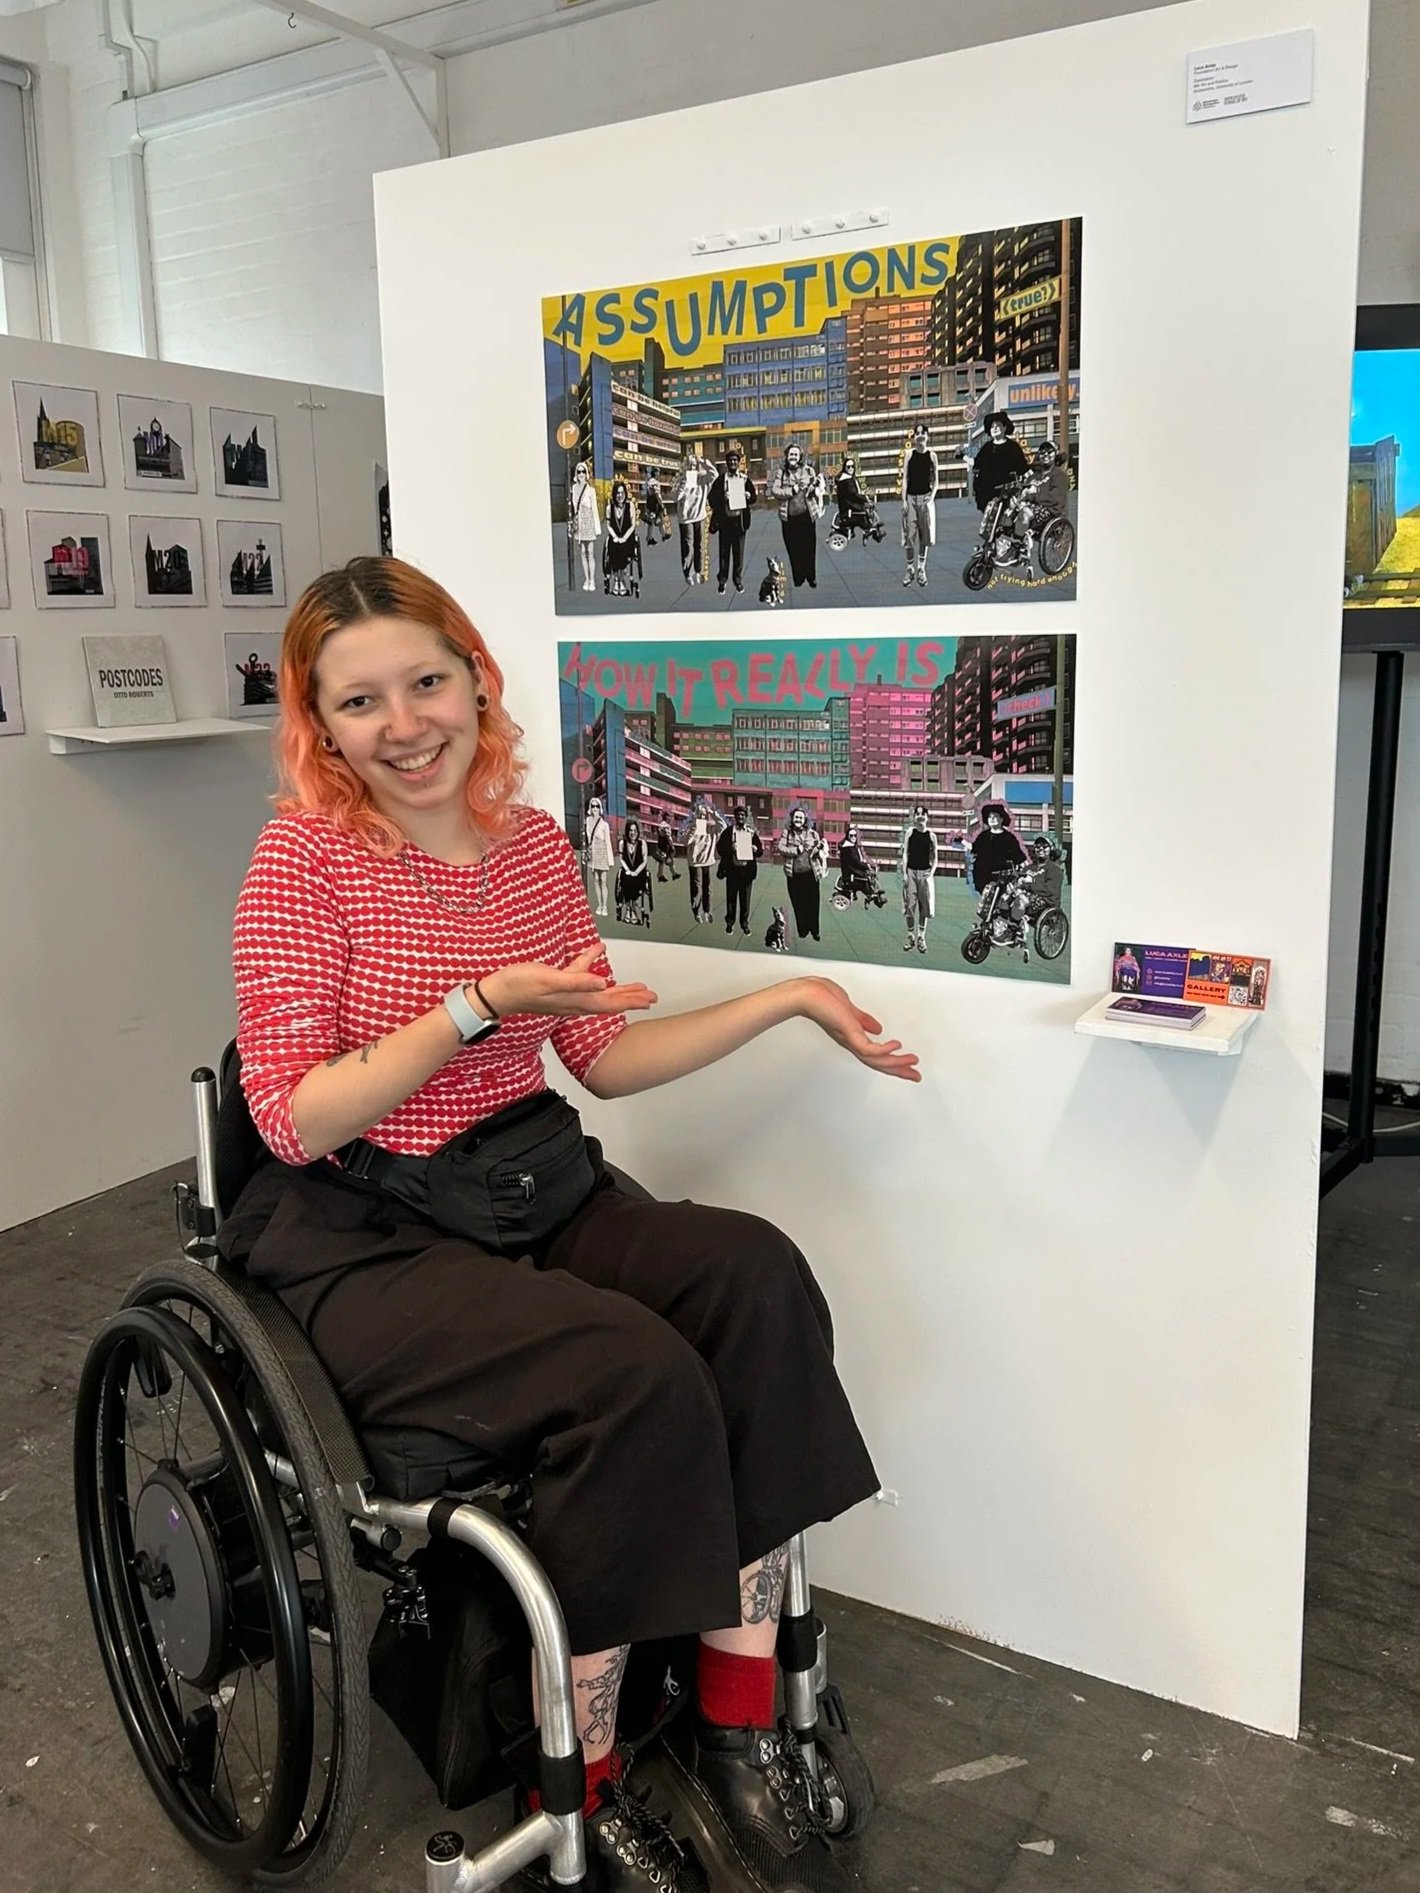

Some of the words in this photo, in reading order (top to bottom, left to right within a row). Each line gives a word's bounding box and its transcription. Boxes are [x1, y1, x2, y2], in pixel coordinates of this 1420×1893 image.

[553, 243, 950, 357] ASSUMPTIONS
[614, 450, 642, 461] can
[645, 454, 659, 464] be
[1000, 573, 1026, 587] trying
[1027, 576, 1046, 588] hard
[1047, 561, 1078, 583] enough
[98, 668, 164, 688] POSTCODES
[564, 643, 657, 708] HOW
[666, 659, 703, 719] IT
[710, 644, 878, 709] REALLY
[897, 641, 945, 686] IS
[113, 691, 128, 699] OTTO
[128, 690, 154, 699] ROBERTS
[1187, 984, 1226, 994] GALLERY
